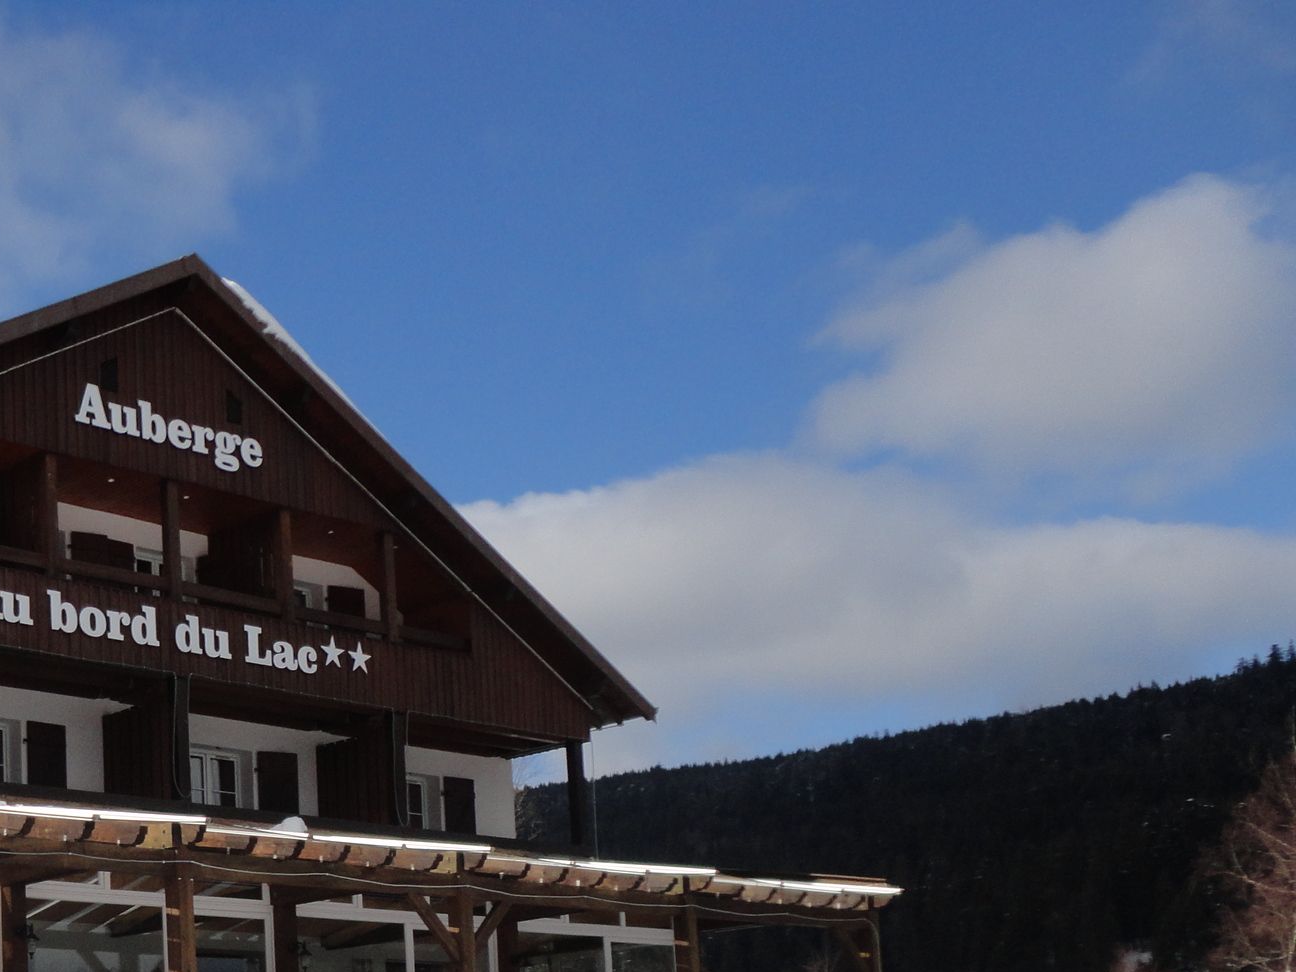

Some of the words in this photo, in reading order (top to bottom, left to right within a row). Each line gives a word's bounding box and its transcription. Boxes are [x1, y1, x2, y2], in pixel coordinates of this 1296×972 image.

[75, 383, 263, 472] Auberge
[46, 589, 160, 647] bord
[175, 614, 232, 660] du
[244, 624, 318, 674] Lac
